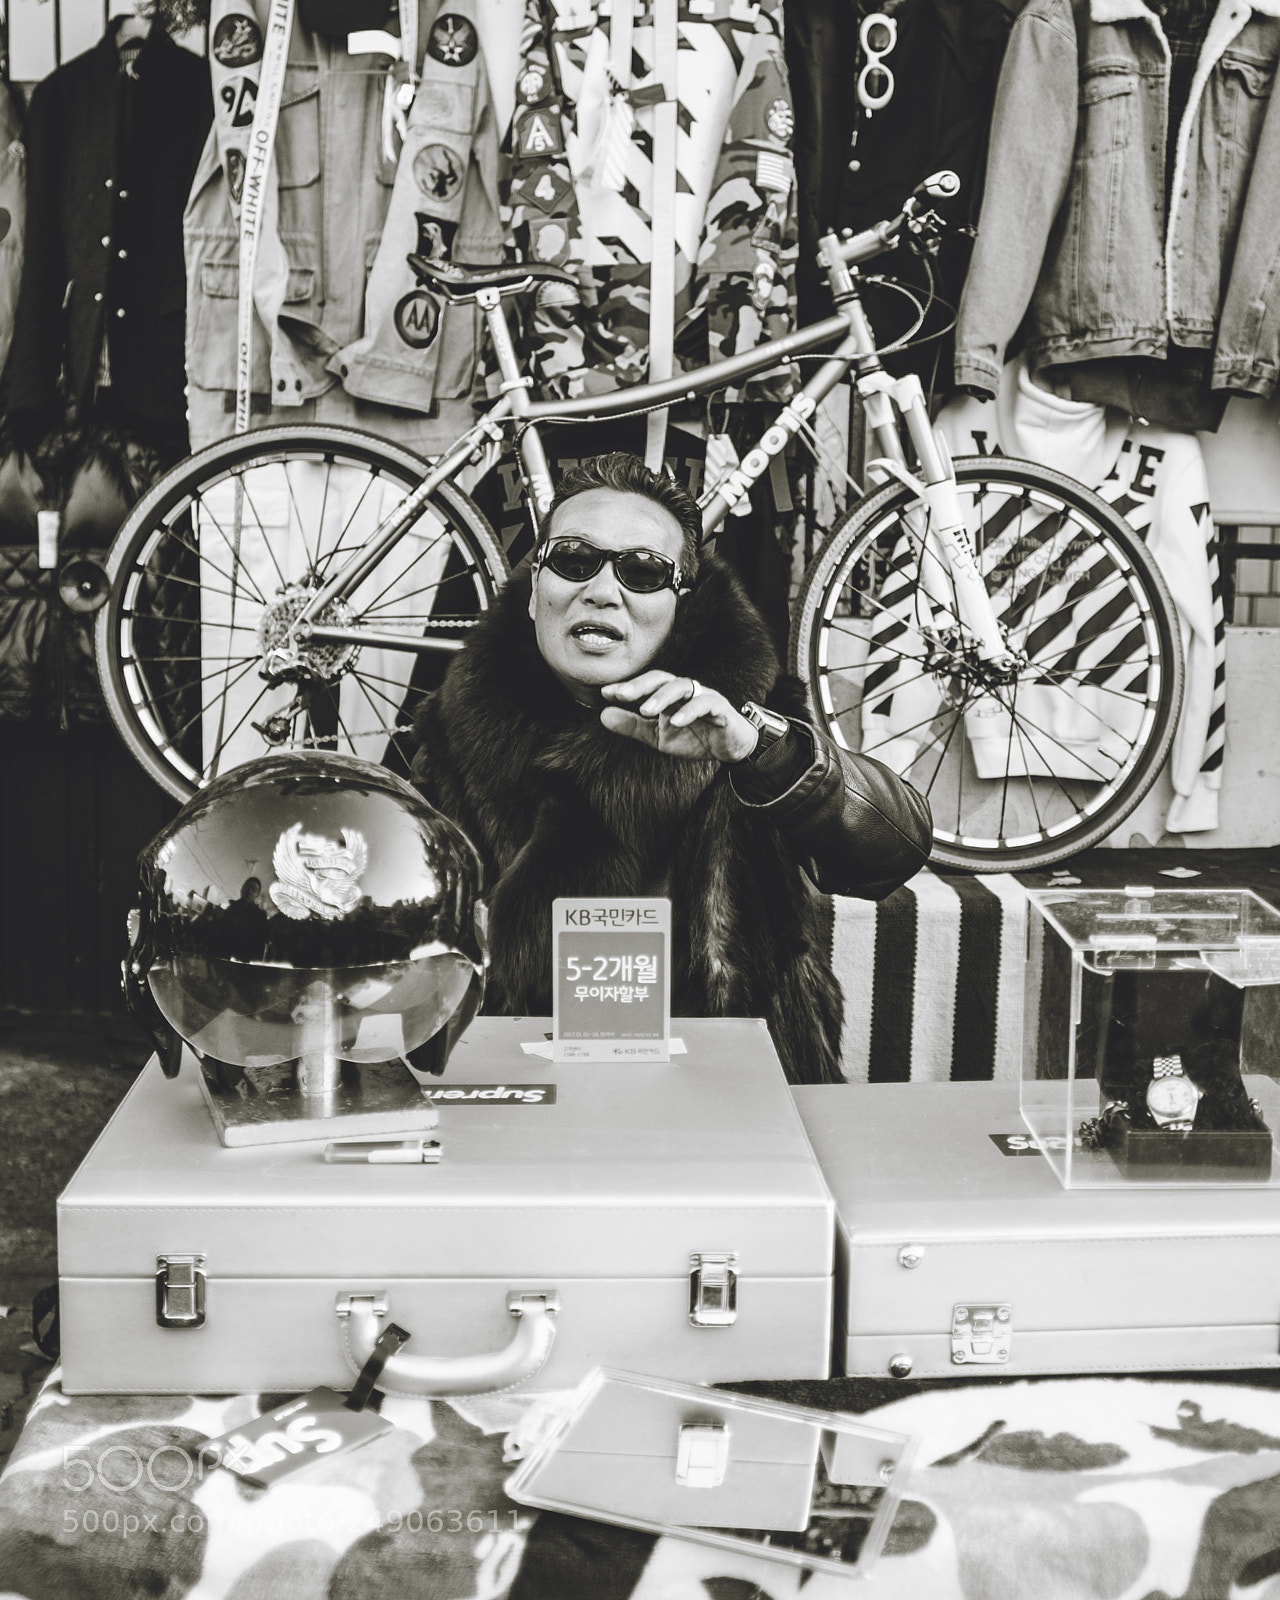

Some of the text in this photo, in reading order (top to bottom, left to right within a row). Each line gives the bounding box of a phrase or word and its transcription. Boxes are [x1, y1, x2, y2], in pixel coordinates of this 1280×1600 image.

[243, 130, 270, 241] OFF-WHITE
[534, 174, 556, 201] 4
[565, 908, 659, 927] KB국민카드
[573, 985, 649, 1003] 무이자할부
